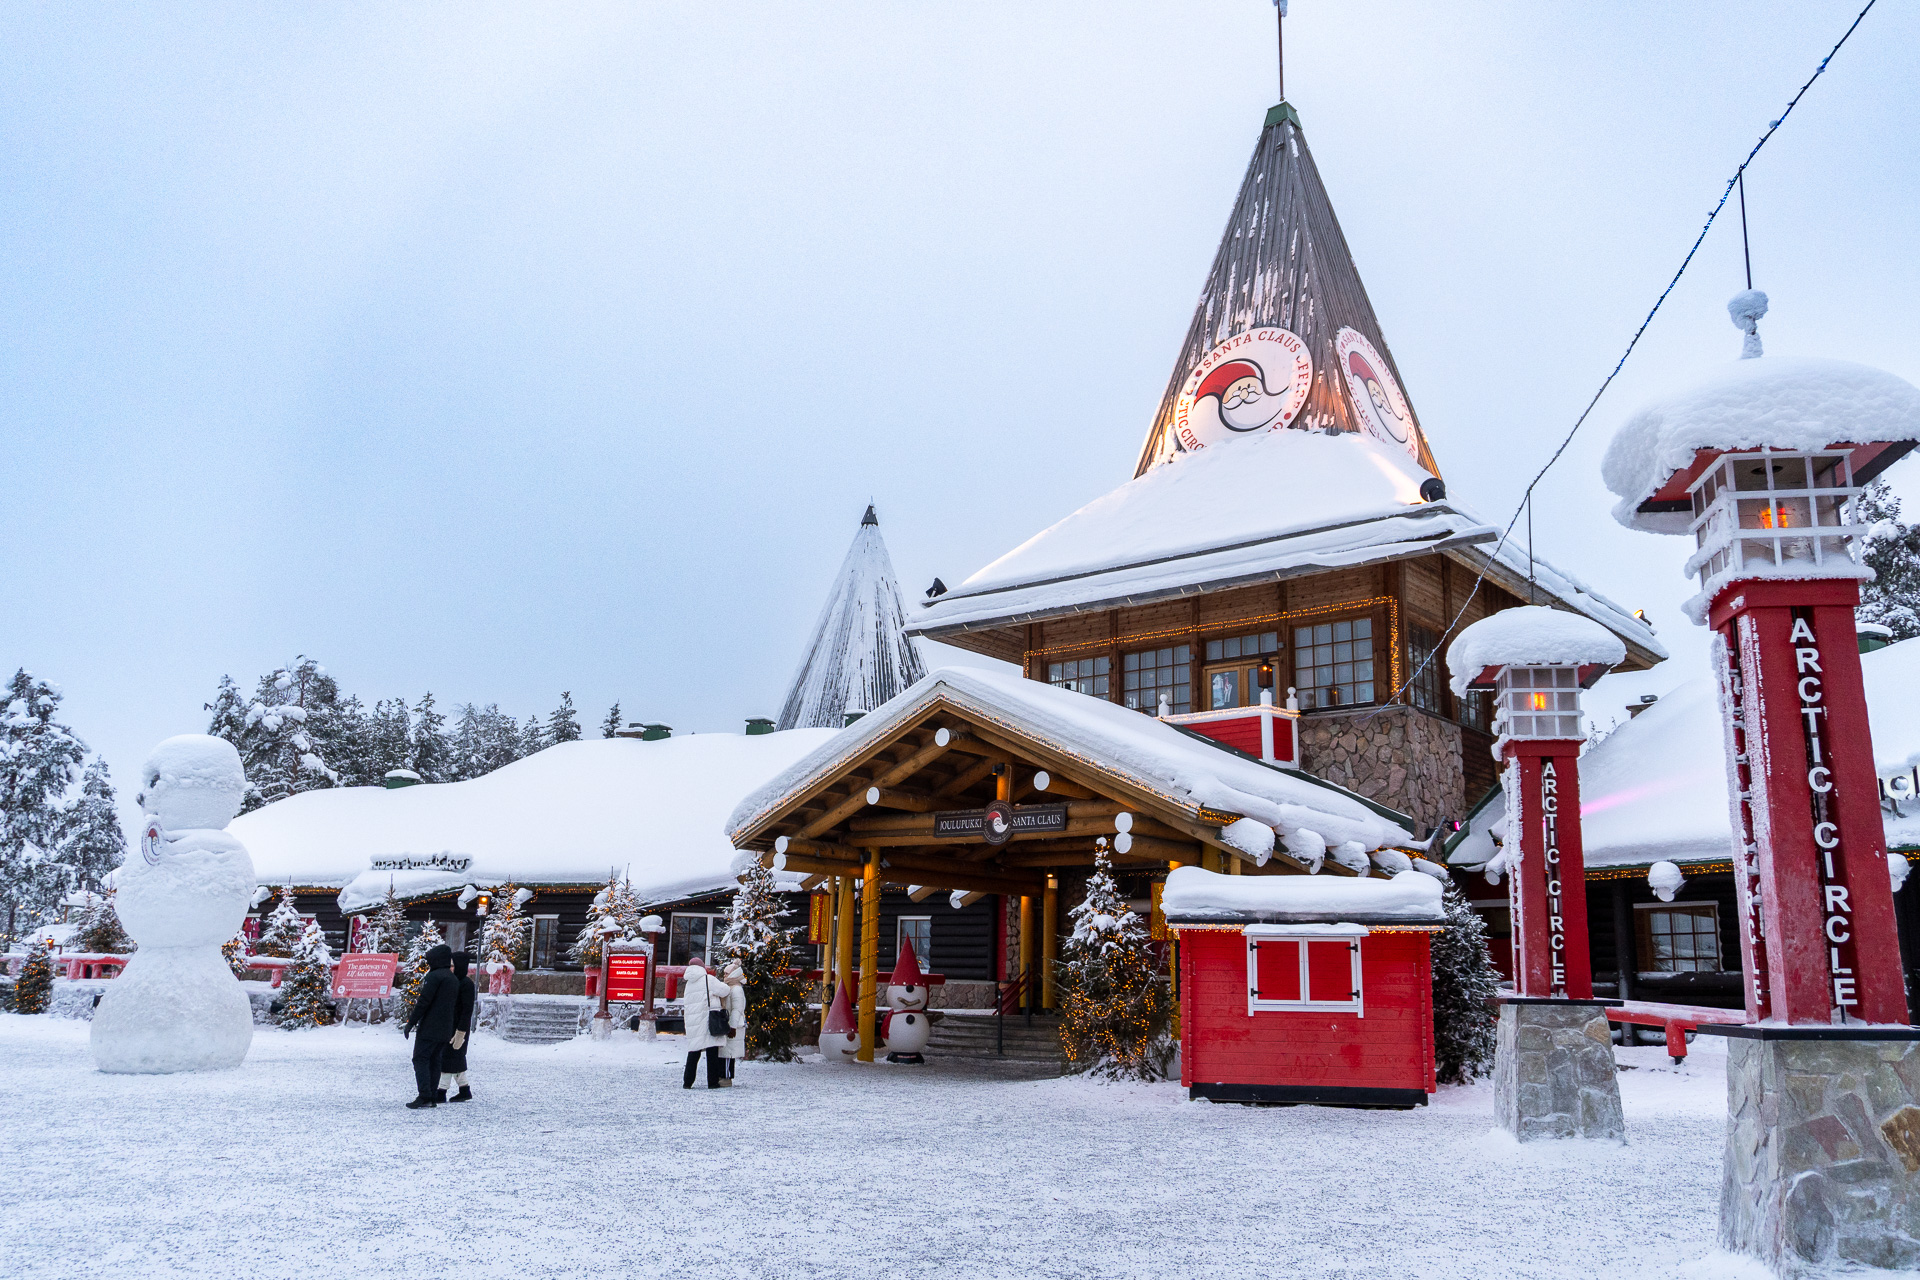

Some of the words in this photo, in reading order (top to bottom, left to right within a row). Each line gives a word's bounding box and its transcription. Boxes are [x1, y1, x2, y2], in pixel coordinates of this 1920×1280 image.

[1203, 333, 1252, 368] SANTA
[1258, 330, 1301, 353] CLAUS
[1366, 343, 1396, 386] CLAUS
[939, 818, 982, 831] JOULUPUKKI
[1012, 815, 1036, 827] SANTA
[1037, 814, 1061, 825] CLAUS
[1543, 761, 1560, 864] ARCTIC
[1790, 617, 1833, 793] ARCTIC
[1814, 821, 1858, 1005] CIRCLE
[1548, 880, 1565, 985] CIRCLE
